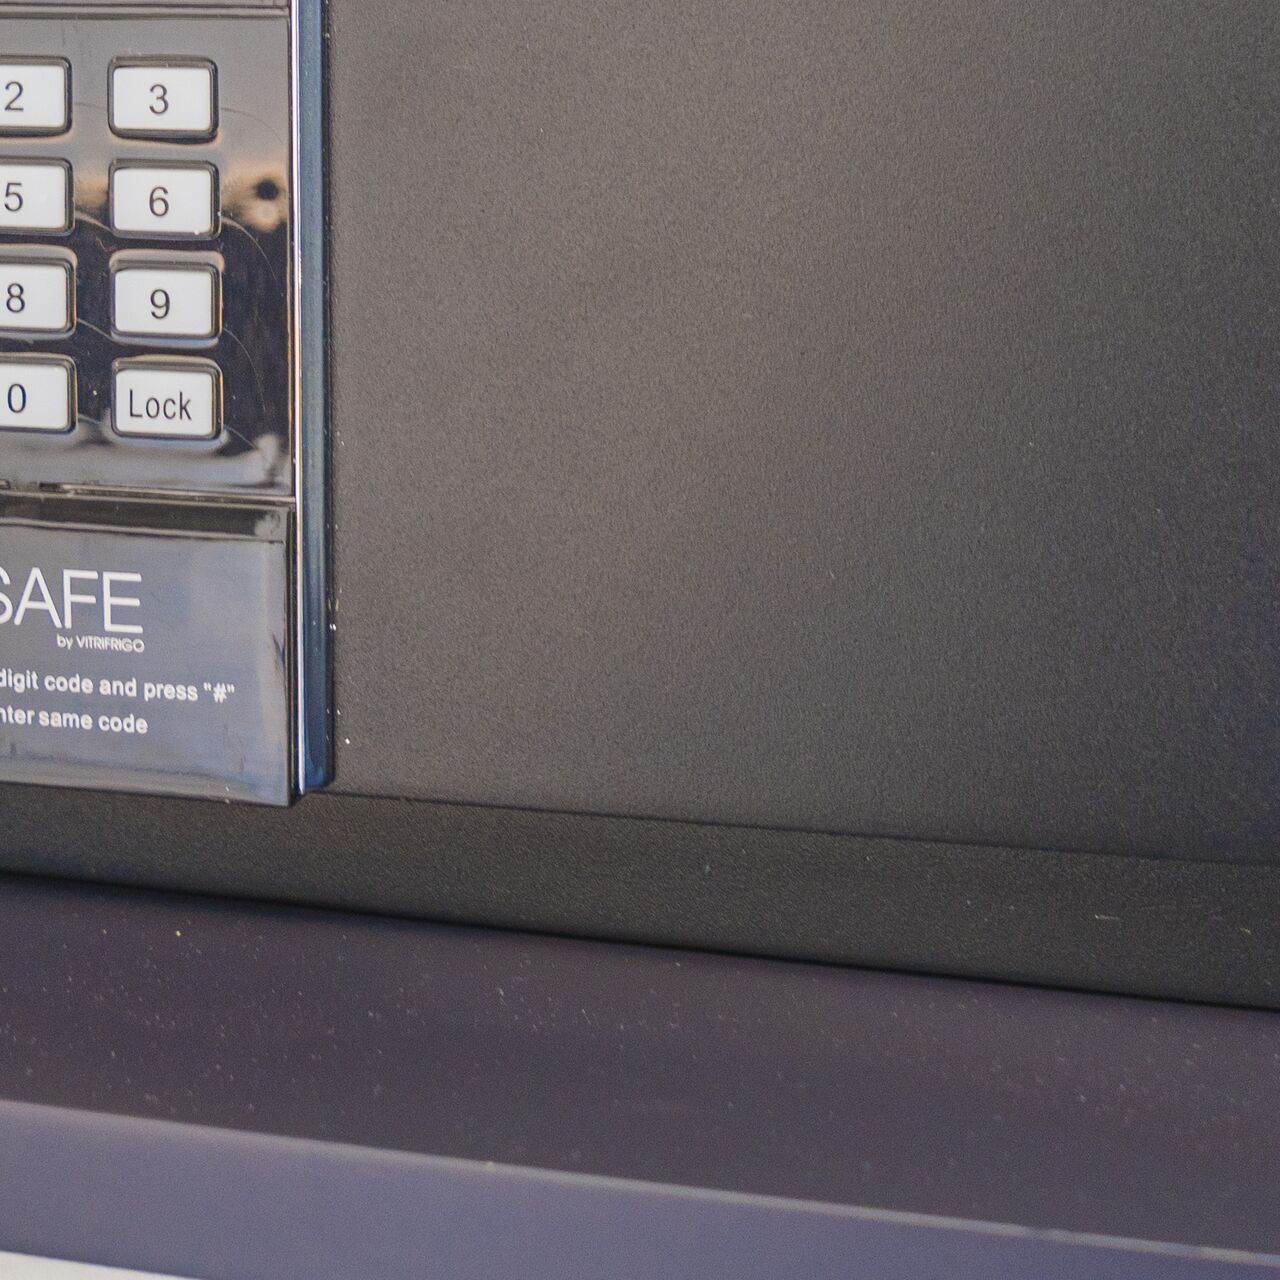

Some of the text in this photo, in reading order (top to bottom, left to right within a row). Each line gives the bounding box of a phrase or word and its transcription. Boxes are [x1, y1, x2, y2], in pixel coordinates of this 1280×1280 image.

[4, 81, 24, 112] 2
[149, 83, 169, 115] 3
[4, 182, 24, 213] 5
[149, 186, 170, 217] 6
[5, 282, 26, 314] 8
[150, 288, 171, 320] 9
[7, 383, 27, 414] 0
[129, 389, 192, 421] Lock
[56, 634, 145, 653] by VITRIFRIGO
[44, 673, 94, 694] code
[99, 677, 137, 697] and
[143, 682, 199, 702] press
[38, 710, 93, 730] same
[98, 713, 149, 734] code
